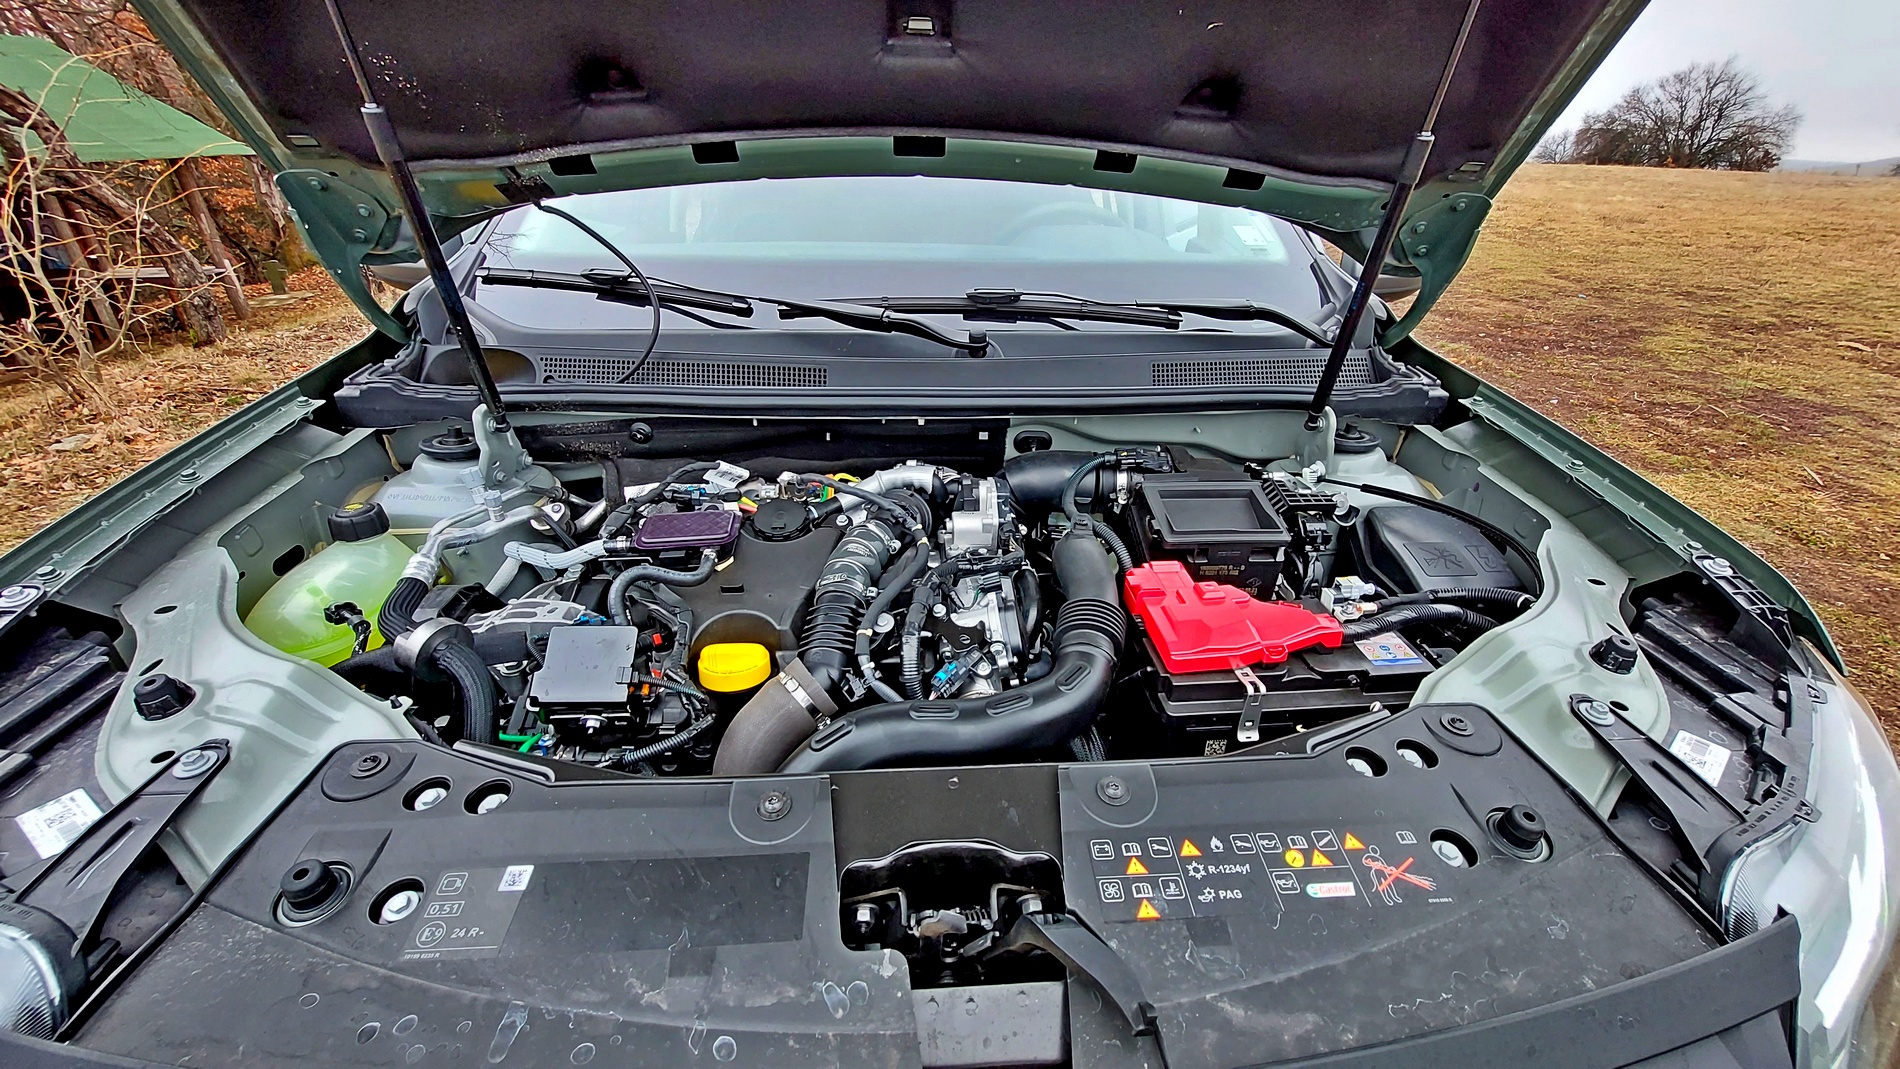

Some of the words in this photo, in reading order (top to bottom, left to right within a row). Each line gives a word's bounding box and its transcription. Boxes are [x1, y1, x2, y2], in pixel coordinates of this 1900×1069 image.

[1207, 863, 1251, 875] R-1234yf
[1218, 889, 1243, 900] PAG
[1319, 884, 1352, 895] Castrol
[450, 928, 467, 938] 24
